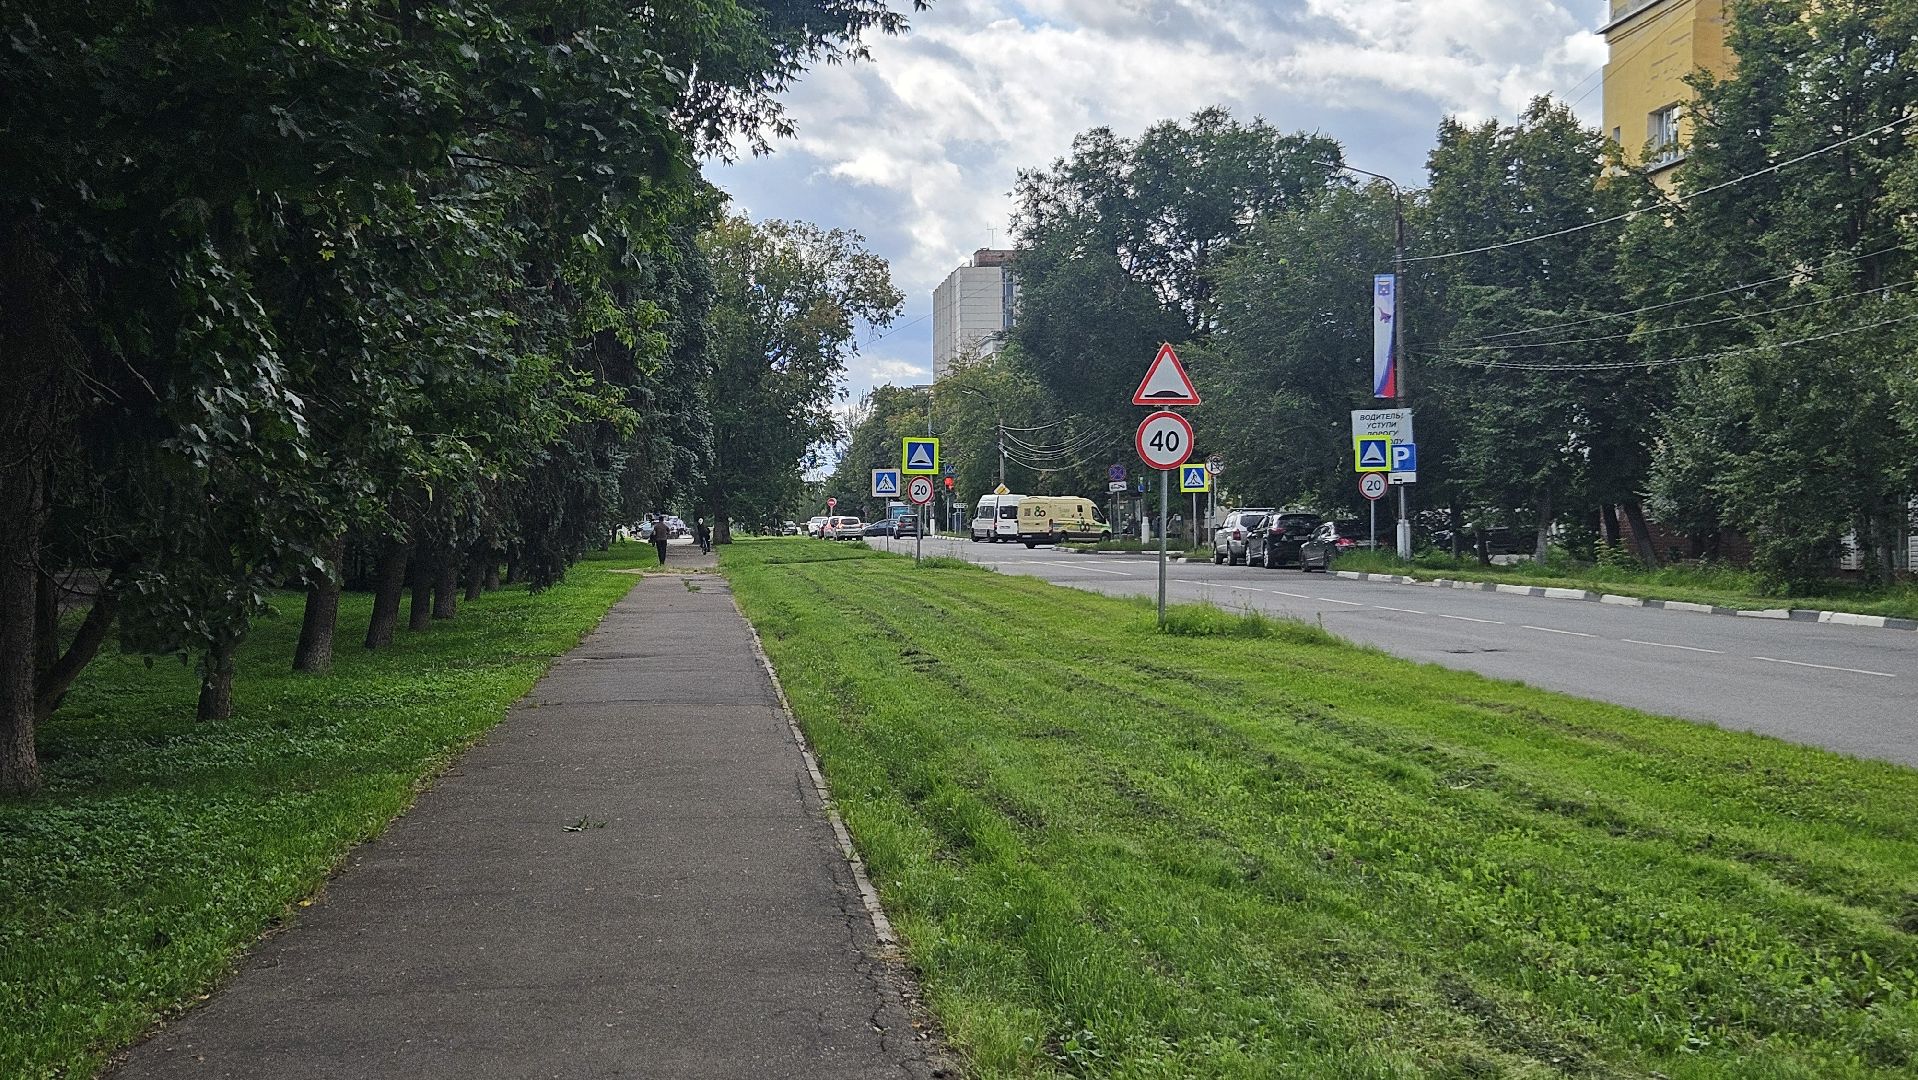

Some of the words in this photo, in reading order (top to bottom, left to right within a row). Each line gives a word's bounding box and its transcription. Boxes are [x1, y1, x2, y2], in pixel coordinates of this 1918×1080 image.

[1359, 413, 1404, 421] ВОДИТЕЛЬ!
[1149, 430, 1179, 452] 40
[914, 485, 927, 495] 20
[1366, 480, 1381, 491] 20
